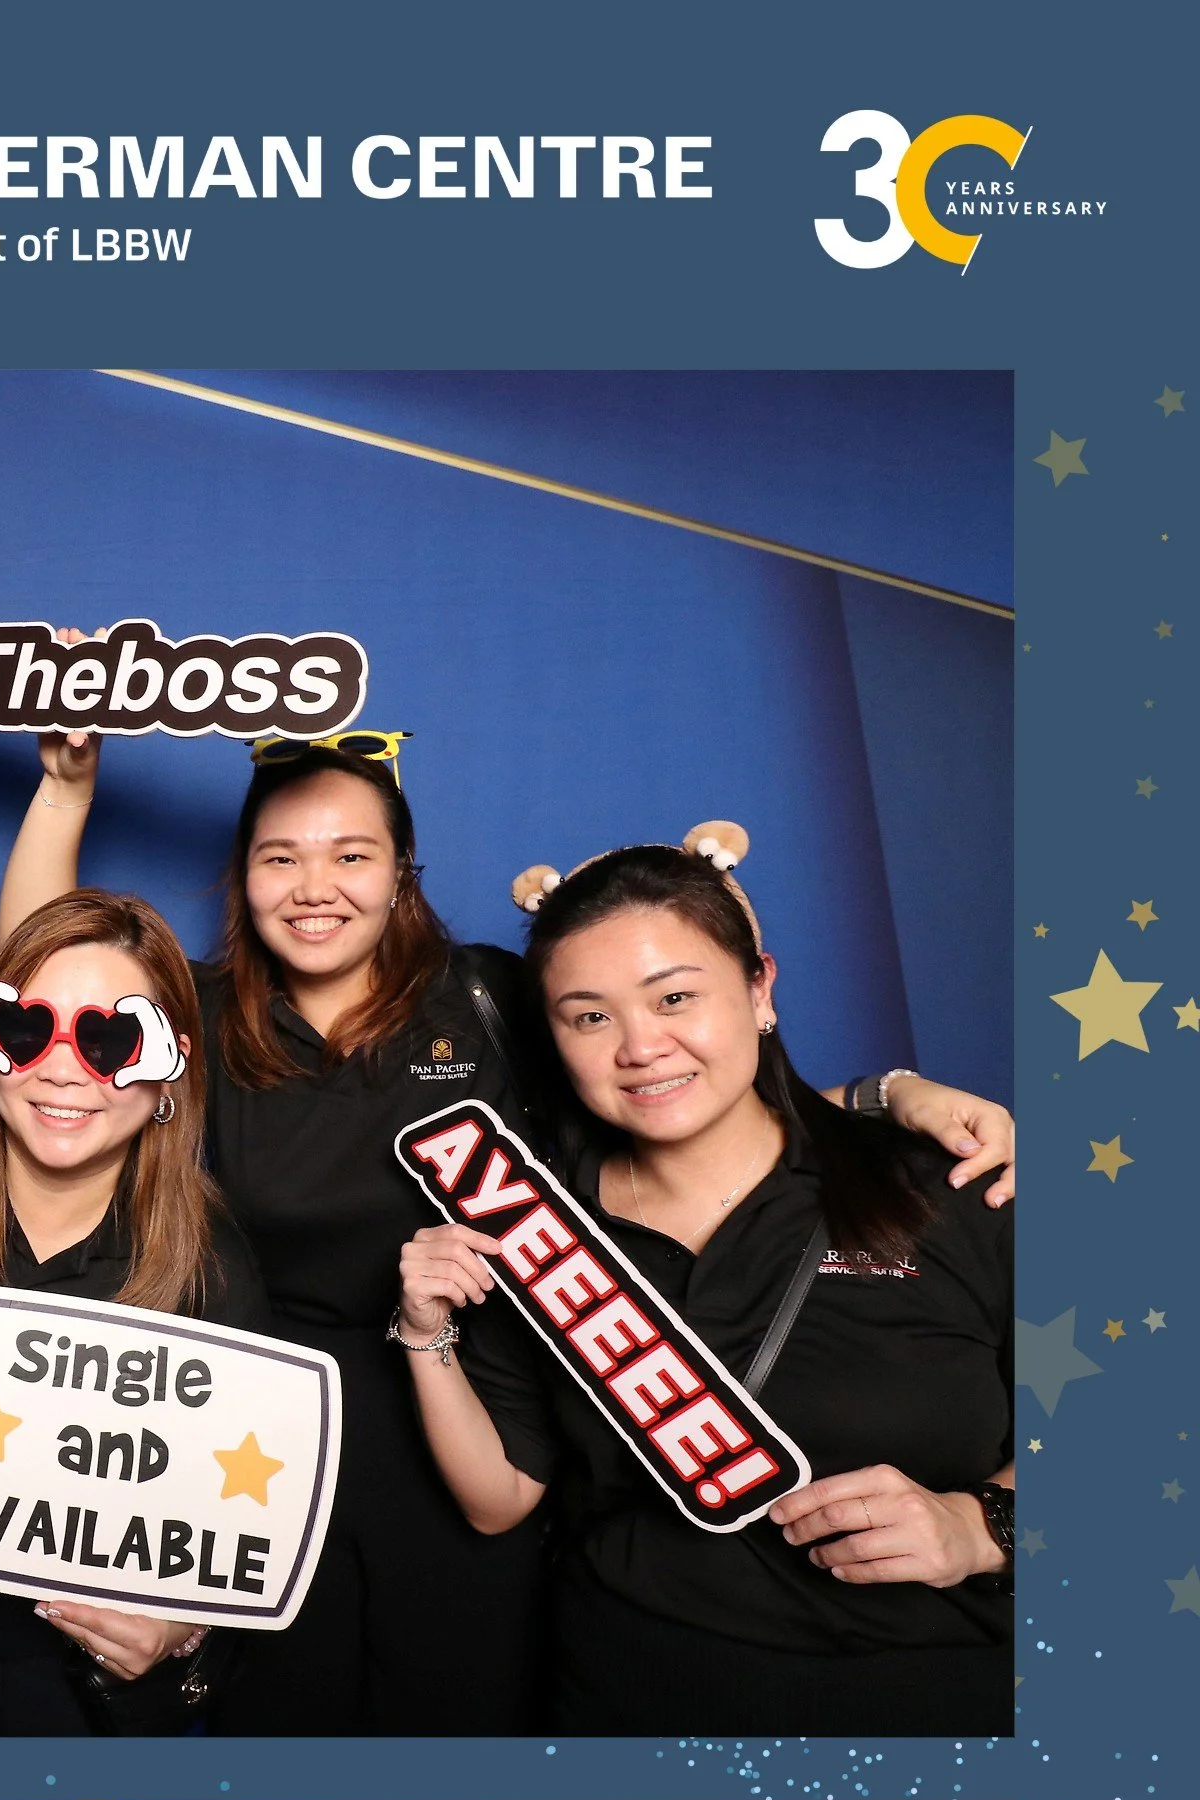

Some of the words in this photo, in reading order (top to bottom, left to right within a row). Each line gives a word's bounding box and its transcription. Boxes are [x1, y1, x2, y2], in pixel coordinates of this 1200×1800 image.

[410, 1064, 432, 1074] PAN
[435, 1063, 476, 1074] PACIFIC
[411, 1119, 781, 1509] AYEEEEE!
[8, 1329, 213, 1408] Single
